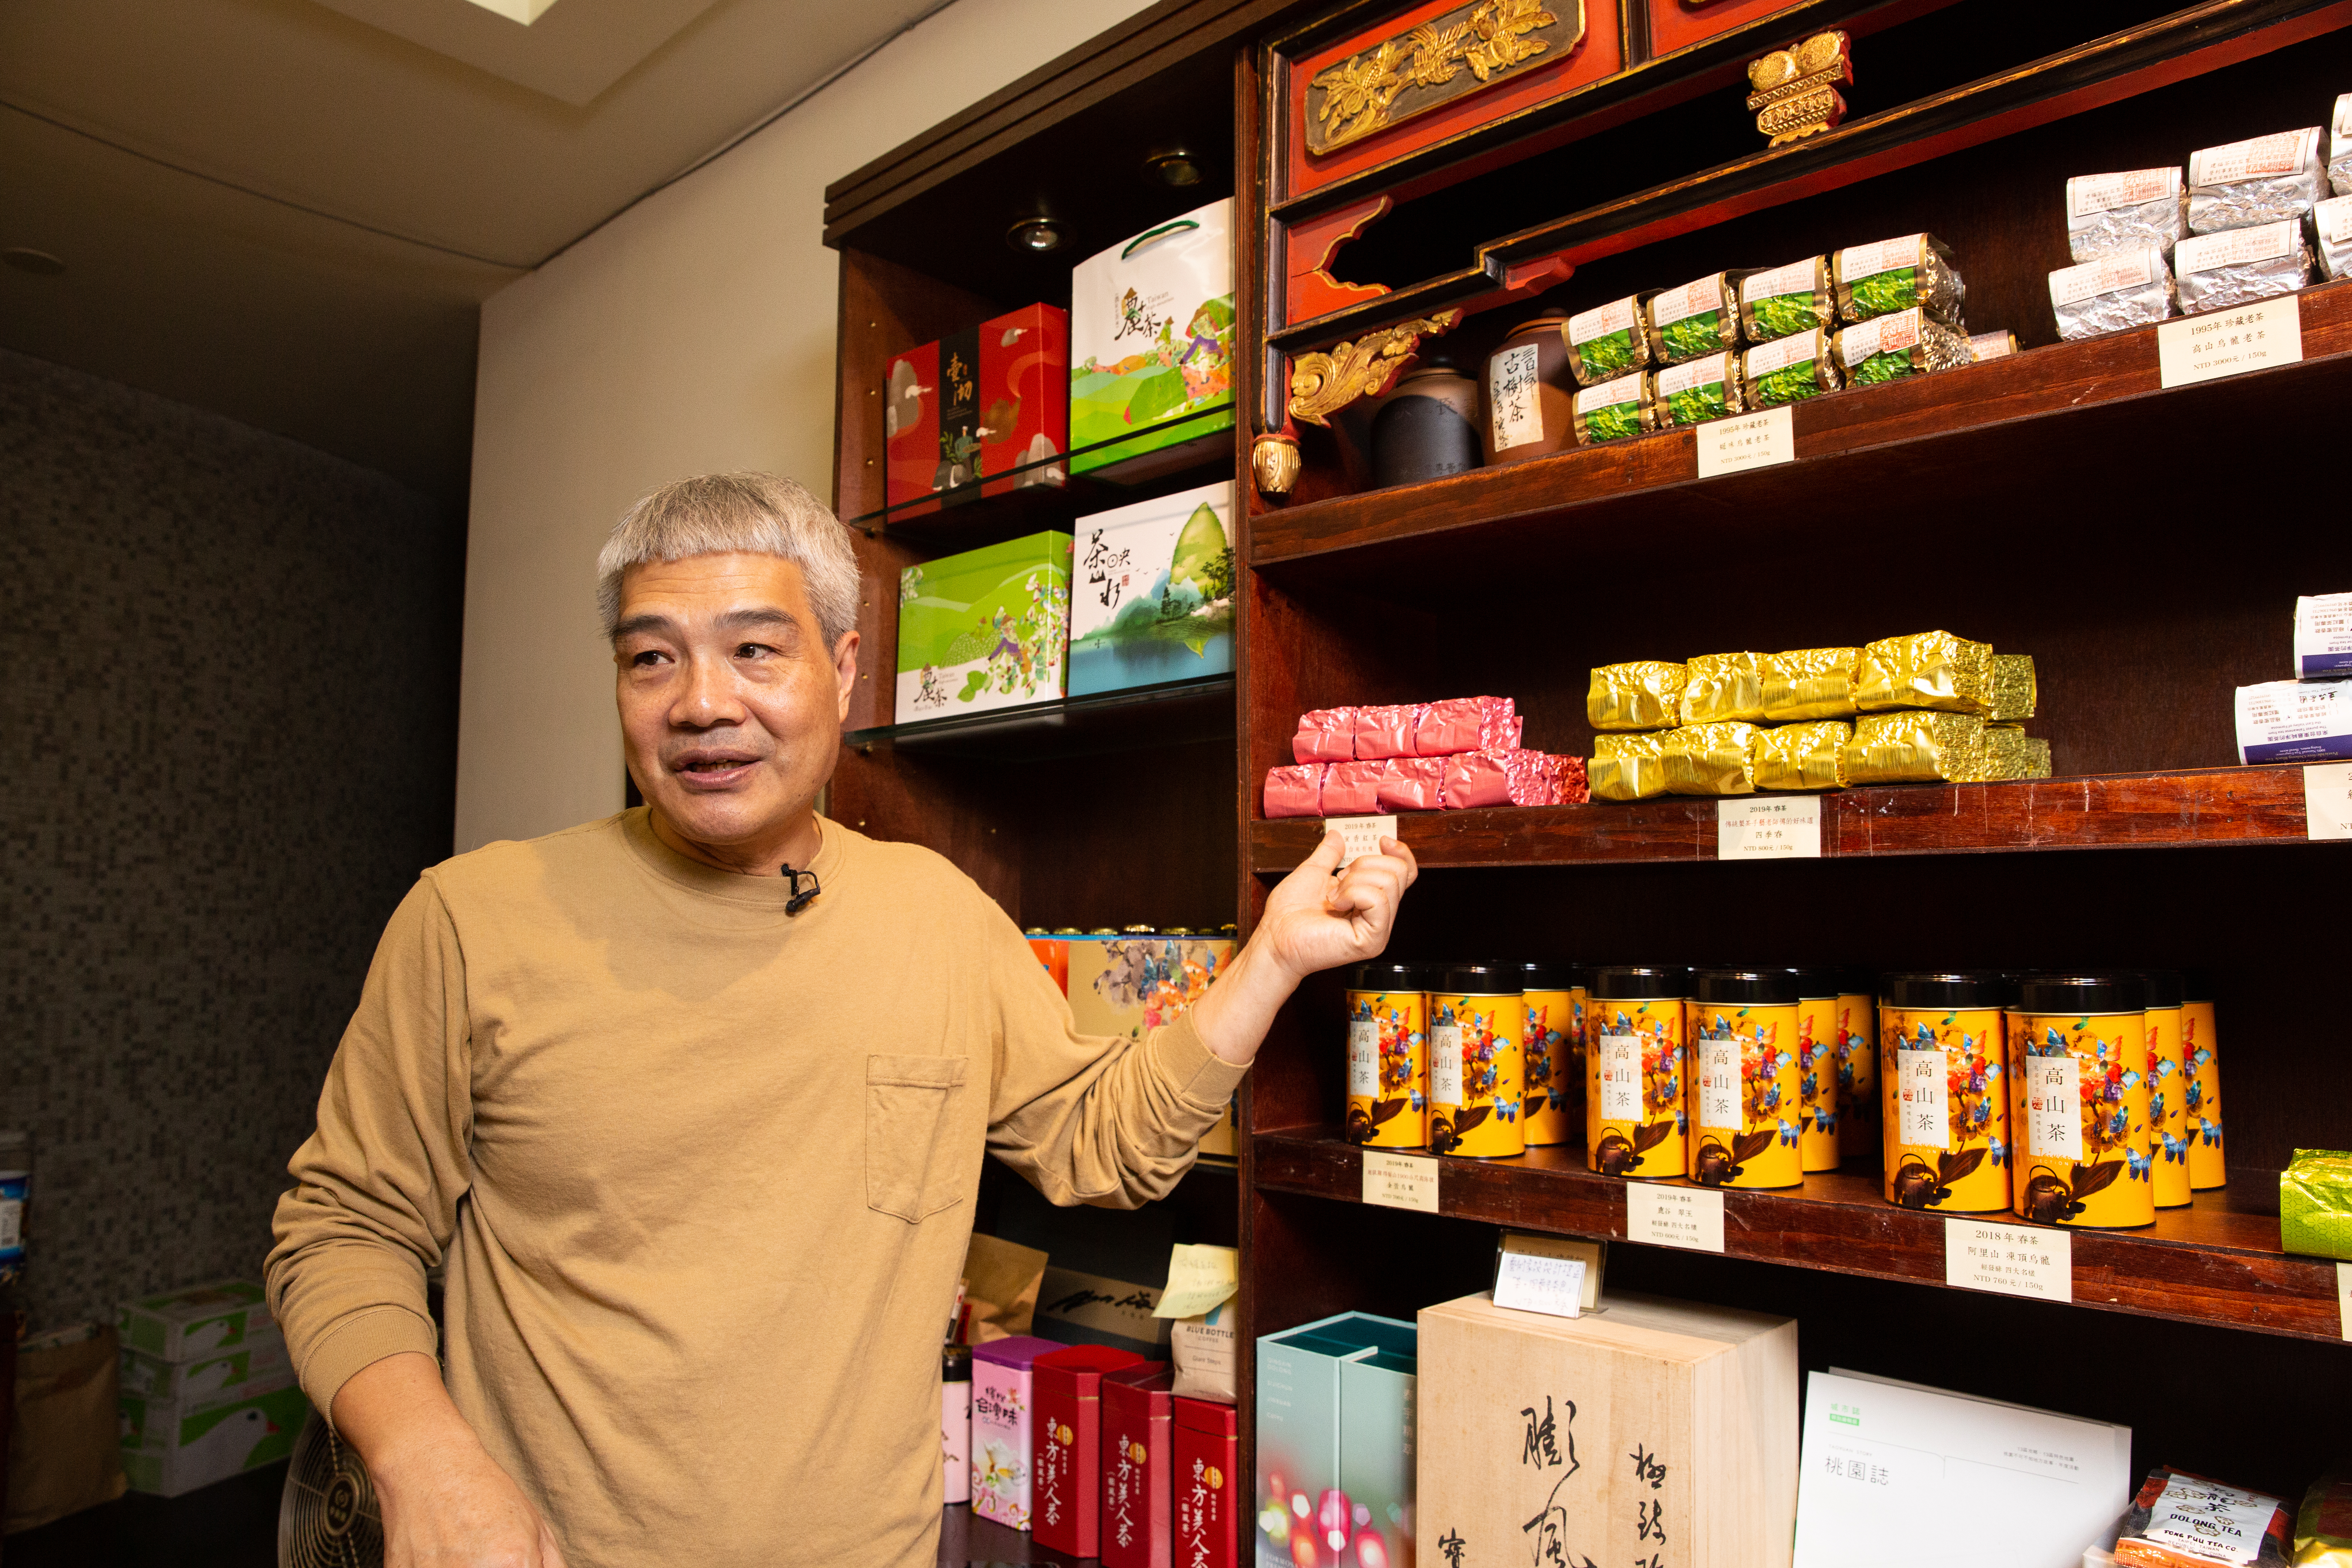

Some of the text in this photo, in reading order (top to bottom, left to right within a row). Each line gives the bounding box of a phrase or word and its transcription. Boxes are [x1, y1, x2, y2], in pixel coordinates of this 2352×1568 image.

[2191, 312, 2264, 335] 1995年 珍藏老茶
[2192, 331, 2265, 354] 高山烏龍老茶
[1521, 347, 1537, 400] 三百年
[2194, 362, 2210, 370] NTD
[2213, 356, 2239, 366] 3000元
[1503, 353, 1527, 423] 古樹茶
[1720, 419, 1769, 435] 1995年 珍藏老茶
[2267, 730, 2328, 742] 來自台東最純淨的茶園
[1725, 817, 1814, 828] 傳統製茶手藝老師傅的好味道
[1345, 834, 1377, 842] 蜜香紅茶
[1756, 830, 1782, 839] 四季春
[1359, 1029, 1369, 1084] 高山茶
[1440, 1034, 1451, 1091] 高山茶
[1615, 1045, 1630, 1106] 高山茶
[1713, 1049, 1728, 1114] 高山茶
[1915, 1060, 1934, 1130] 高山茶
[2045, 1067, 2065, 1141] 高山茶
[1898, 1145, 1936, 1154] SELECTION
[2038, 1147, 2073, 1160] Taiwan
[2027, 1157, 2069, 1166] SELECTION
[1976, 1230, 2000, 1240] 2018
[2017, 1234, 2038, 1245] 春茶
[1968, 1246, 2050, 1265] 阿里山 凍頂烏龍
[1981, 1263, 2002, 1272] 輕發酵
[2025, 1282, 2043, 1291] 150g
[1186, 1325, 1235, 1339] BLUE BOTTLE
[976, 1397, 1018, 1426] 台灣味
[1044, 1417, 1061, 1526] 東方美人茶
[1825, 1456, 1889, 1485] 桃園誌
[1115, 1434, 1134, 1548] 東方美人茶
[1189, 1457, 1210, 1568] 東方美人茶
[2170, 1514, 2242, 1537] OOLONG TEA
[2168, 1540, 2195, 1551] REPUBLIC
[2187, 1535, 2204, 1544] PUU
